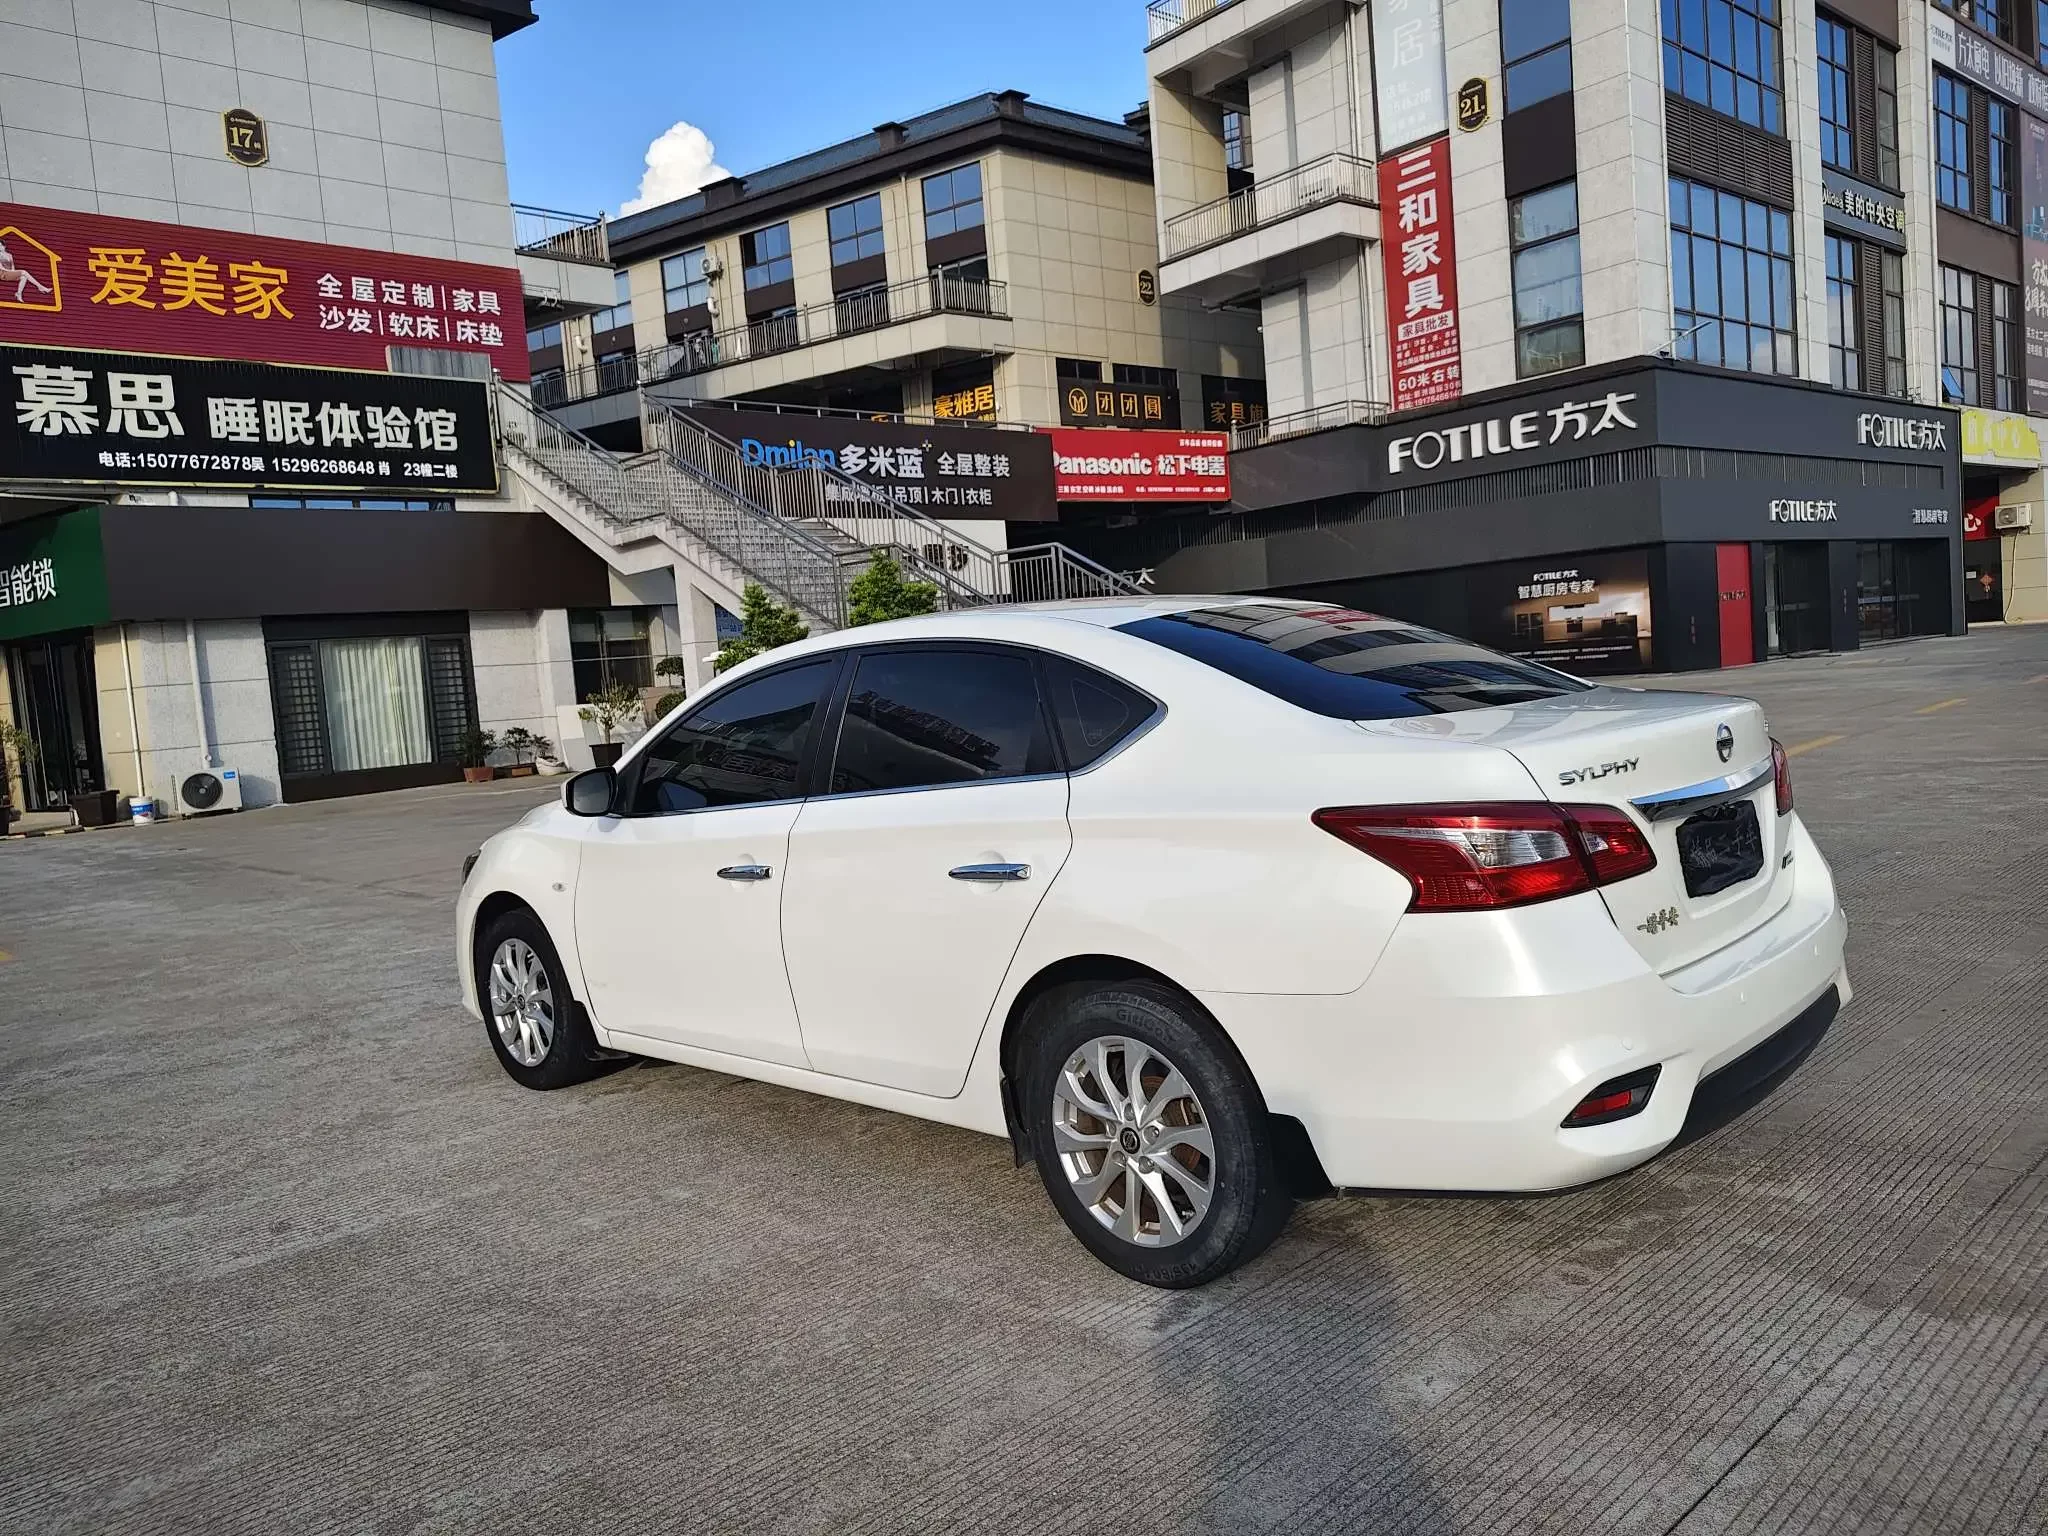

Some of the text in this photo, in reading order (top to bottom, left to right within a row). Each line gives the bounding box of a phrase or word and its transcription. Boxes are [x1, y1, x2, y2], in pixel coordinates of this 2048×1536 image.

[1460, 95, 1481, 118] 21
[229, 127, 254, 148] 17
[1845, 188, 1904, 233] 美的中央空调
[1397, 146, 1444, 319] 三和家具
[88, 246, 295, 320] 爱美家
[316, 273, 502, 315] 全屋定制 家具
[319, 304, 504, 348] 沙发 软床 床垫
[1402, 315, 1449, 338] 家具批发
[1398, 364, 1460, 391] 60米右转
[12, 365, 458, 452] 慕思 睡眠体验馆
[934, 384, 994, 417] 豪雅居
[1388, 393, 1637, 474] FOTILE 方太
[1857, 413, 1918, 449] FOTILE
[1917, 419, 1946, 451] 方太
[272, 458, 375, 475] 15296268648
[378, 461, 390, 475] 肖
[403, 462, 458, 479] 23幢二楼
[741, 439, 1011, 479] Dmilan 多米蓝 全屋整装
[1157, 454, 1225, 476] 松下电器
[894, 486, 922, 505] 吊顶
[931, 488, 958, 505] 木门
[966, 488, 992, 506] 衣柜
[1769, 499, 1838, 522] FOTILE 方太
[1518, 580, 1595, 600] 智慧厨房专家
[1533, 572, 1562, 582] FOTILE
[1559, 757, 1640, 786] SYLPHY
